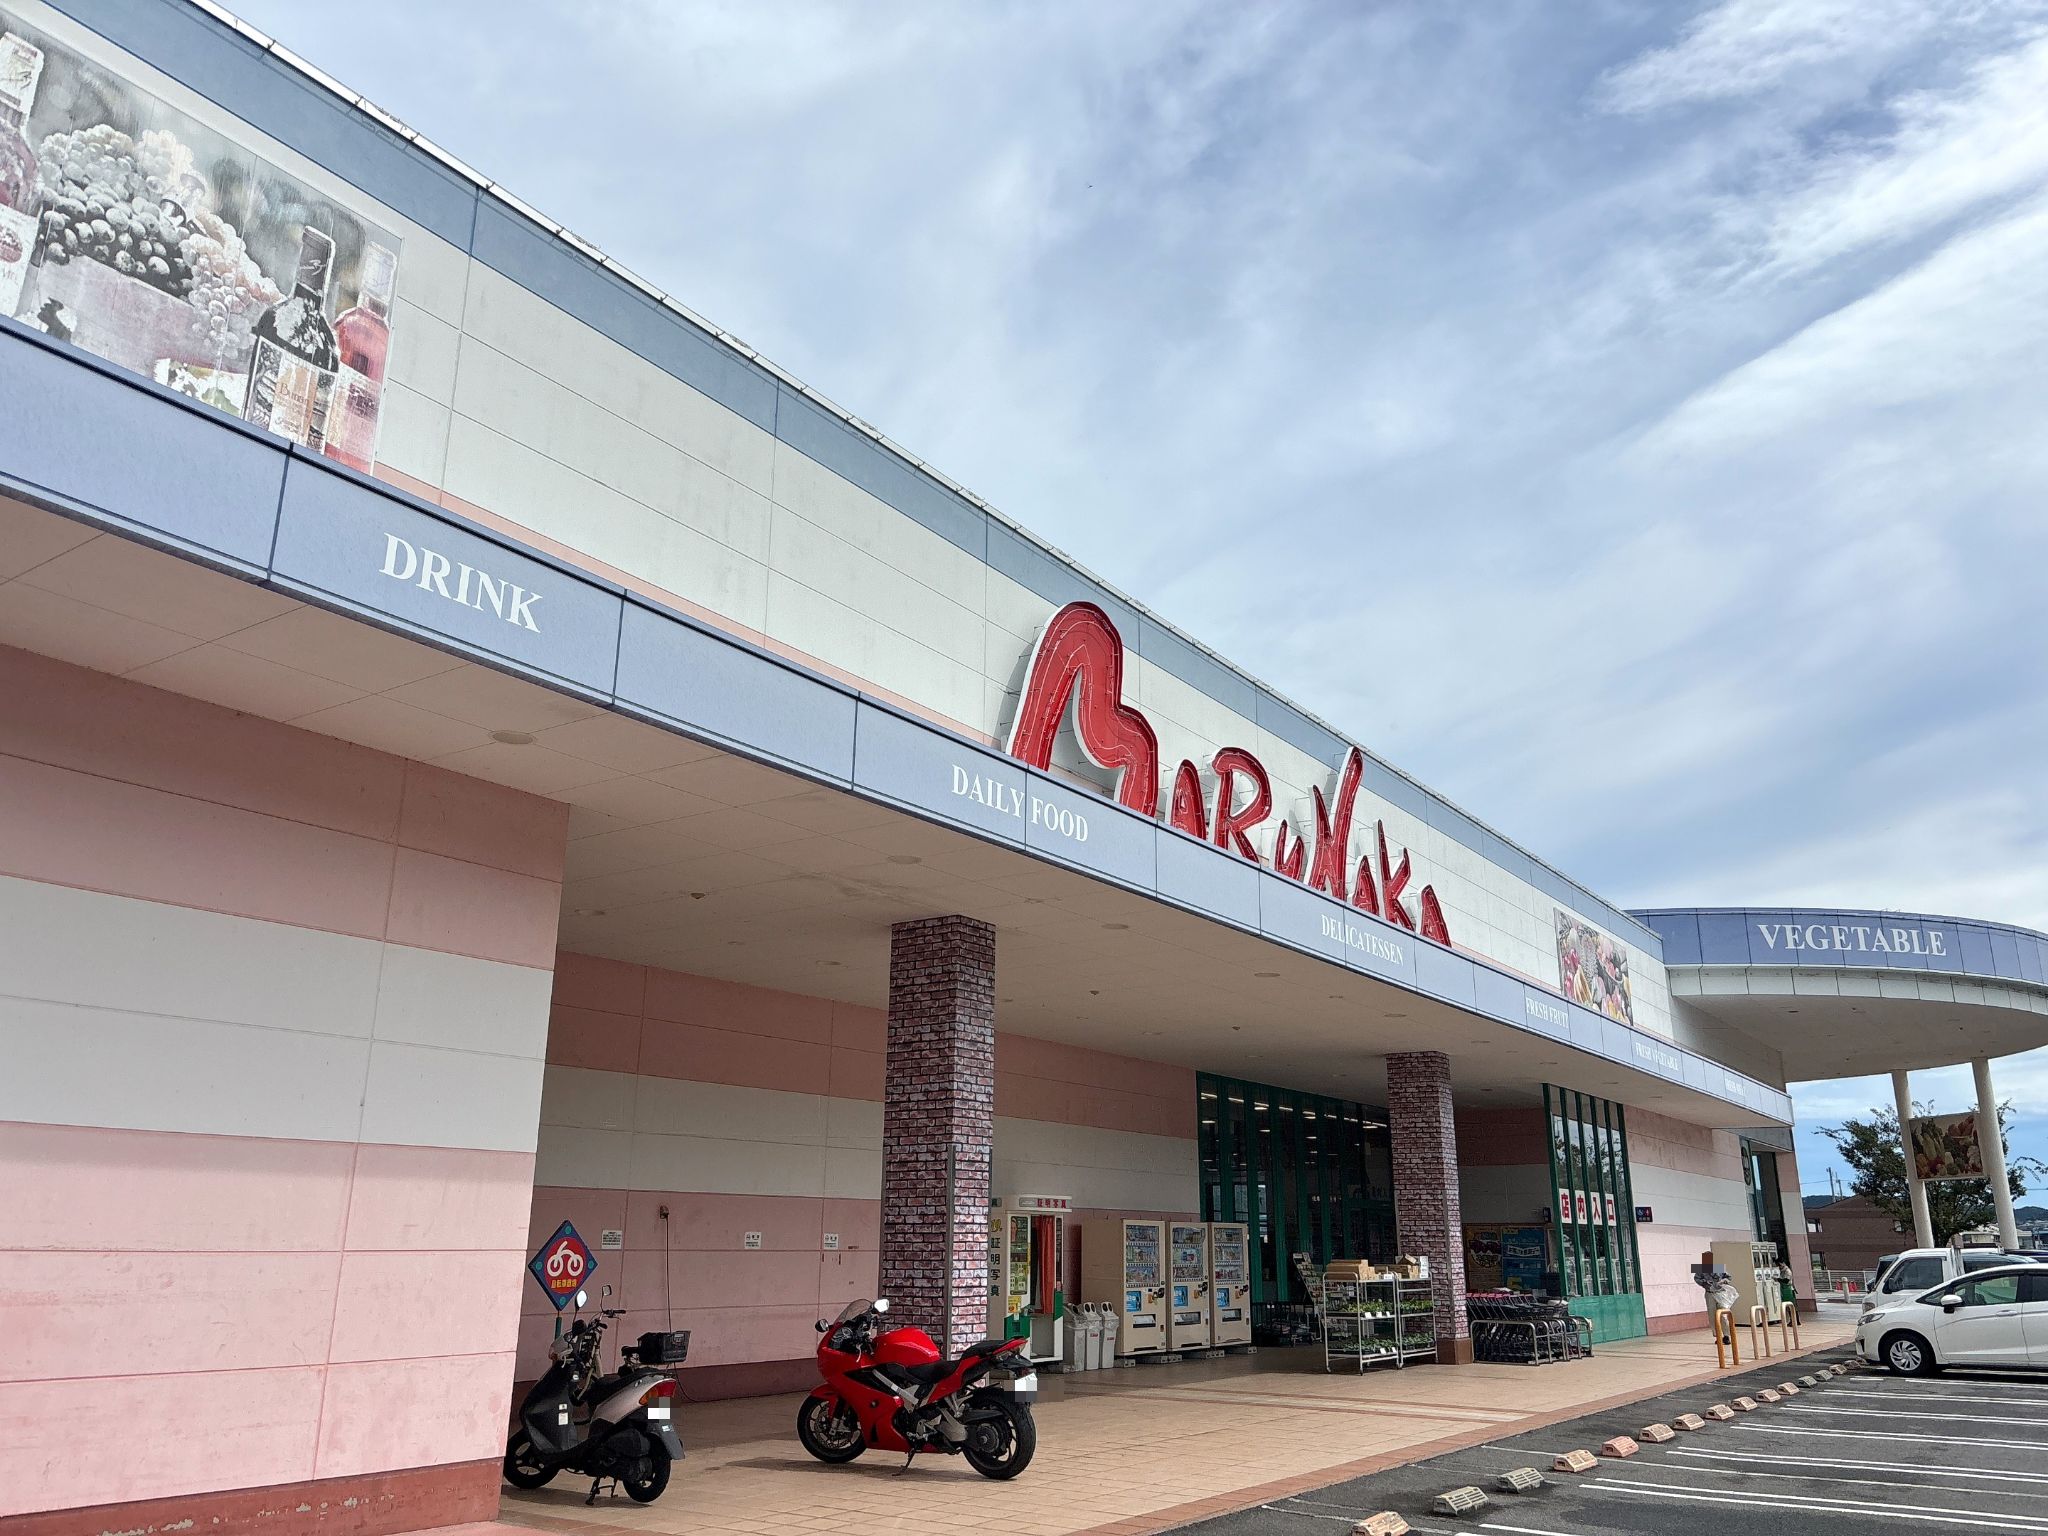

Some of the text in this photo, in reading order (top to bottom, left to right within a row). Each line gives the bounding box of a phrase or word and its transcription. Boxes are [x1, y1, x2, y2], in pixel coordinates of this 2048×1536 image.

[378, 532, 544, 634] DRINK
[951, 764, 1089, 842] DAILY FOOD
[1321, 914, 1404, 967] DELICATESSEN
[1757, 924, 1947, 956] VEGETABLE
[1525, 997, 1569, 1029] FRESH FRUIT
[1560, 1192, 1615, 1221] 店内入口
[990, 1237, 1001, 1297] 証明写真
